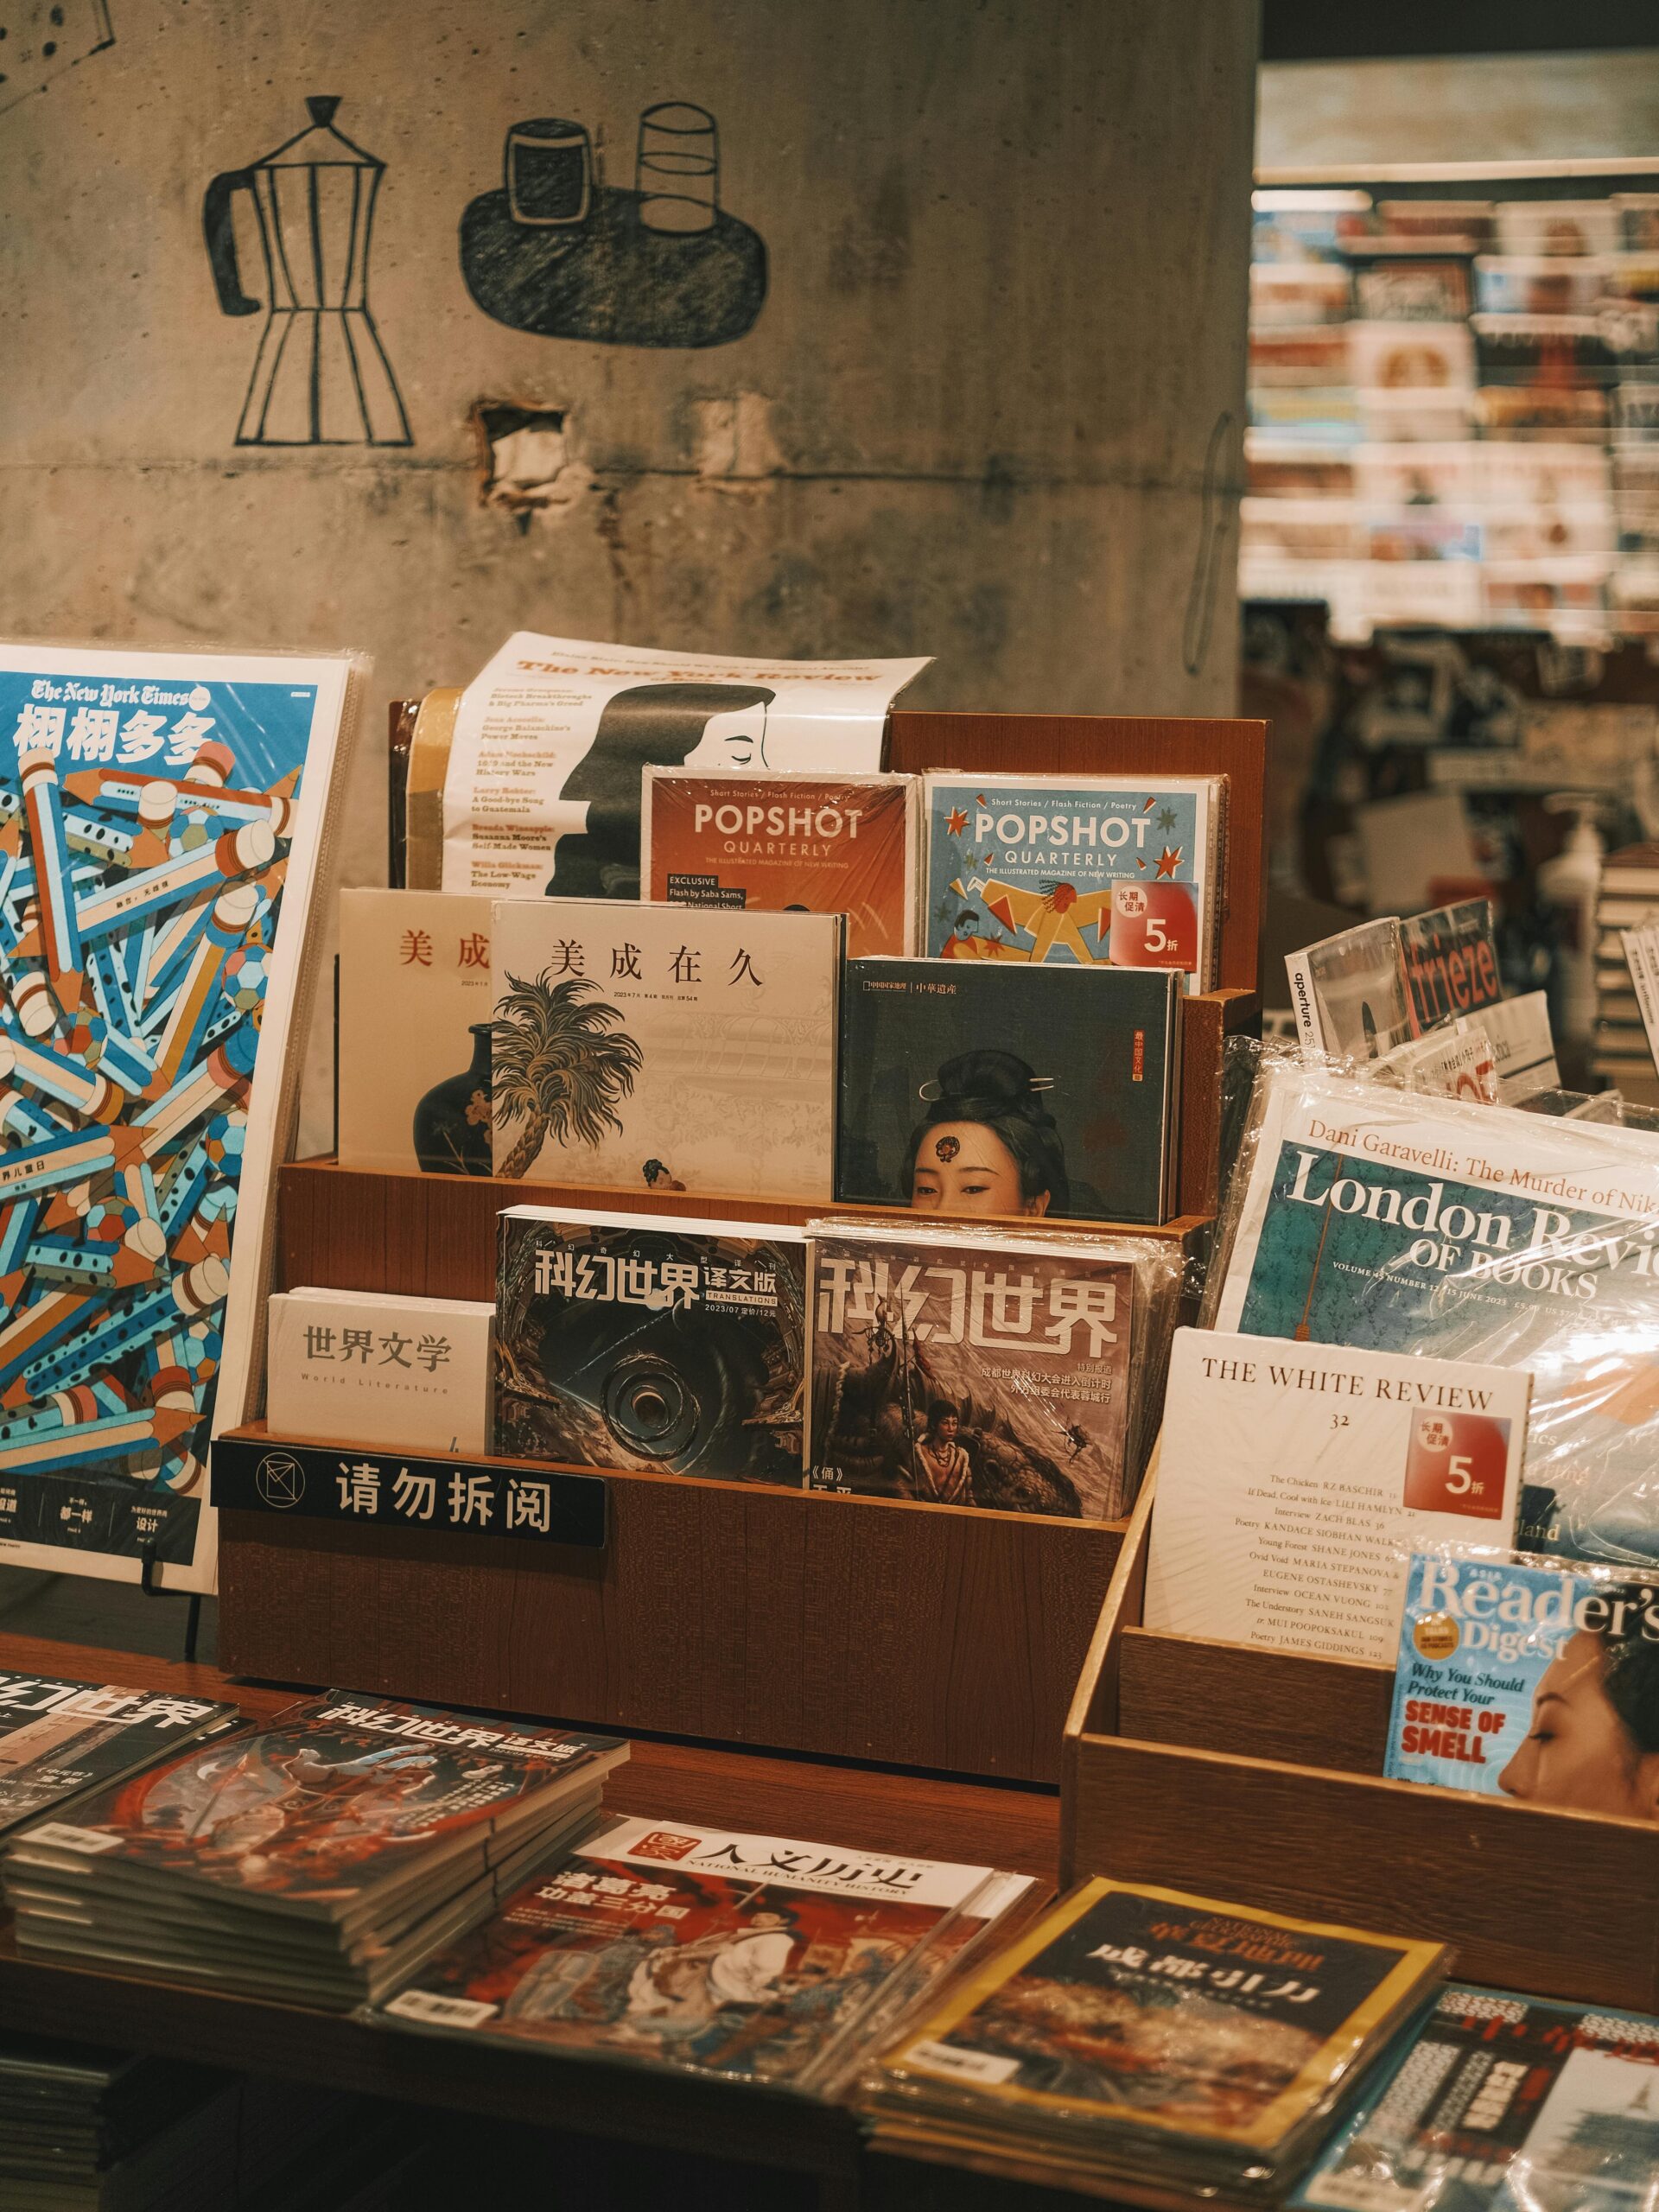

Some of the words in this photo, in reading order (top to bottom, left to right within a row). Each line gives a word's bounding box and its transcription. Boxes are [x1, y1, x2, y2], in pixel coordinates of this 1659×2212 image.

[517, 660, 579, 675] The
[586, 667, 658, 677] New
[664, 671, 741, 681] York
[750, 671, 883, 683] Review
[31, 679, 60, 701] The
[63, 682, 98, 702] New
[99, 685, 139, 708] York
[141, 686, 189, 707] Times
[13, 703, 216, 766] 栩栩多多
[710, 789, 731, 798] Short
[732, 790, 759, 799] Stories
[767, 791, 789, 800] Flash
[790, 792, 816, 801] Fiction
[991, 798, 1014, 807] Short
[1014, 798, 1042, 808] Stories
[1051, 799, 1072, 808] Flash
[1074, 800, 1101, 810] Fiction
[1110, 802, 1137, 812] Poetry
[695, 804, 863, 839] POPSHOT
[975, 813, 1151, 849] POPSHOT
[723, 840, 832, 857] QUARTERLY
[1005, 850, 1117, 868] QUARTERLY
[471, 880, 511, 889] Economy
[669, 875, 716, 887] EXCLUSIVE
[999, 868, 1039, 876] ILLUSTRATED
[1040, 868, 1077, 877] MAGAZINE
[690, 890, 699, 899] by
[701, 891, 720, 899] Saba
[721, 891, 744, 900] Sams,
[1118, 890, 1139, 902] 长期
[1124, 900, 1145, 912] 促清
[1144, 918, 1179, 952] 5折
[400, 930, 490, 969] 美成
[551, 939, 763, 987] 美成在久
[1409, 934, 1498, 1025] frieze
[1294, 972, 1312, 1028] aperture
[1308, 1119, 1359, 1147] Dani
[1363, 1134, 1459, 1173] Garavelli:
[1466, 1157, 1504, 1183] The
[1509, 1168, 1588, 1201] Murder
[1592, 1188, 1618, 1206] of
[1286, 1150, 1510, 1251] London
[535, 1249, 700, 1310] 科幻世界
[703, 1266, 778, 1294] 译文版
[1409, 1238, 1461, 1274] OF
[1467, 1249, 1599, 1300] BOOKS
[1332, 1262, 1372, 1277] VOLUME
[1386, 1274, 1427, 1290] NUMBER
[1446, 1288, 1458, 1297] 15
[1459, 1291, 1484, 1302] JUNE
[1484, 1296, 1507, 1306] 2023
[704, 1303, 739, 1314] 2023/07
[741, 1306, 778, 1319] 定价/12元
[707, 1292, 778, 1306] TRANSLATIONS
[817, 1257, 1118, 1359] 科幻世界
[302, 1325, 452, 1373] 世界文学
[1077, 1362, 1113, 1376] 特别报道
[301, 1372, 346, 1384] World
[358, 1378, 448, 1395] Literature
[1201, 1357, 1256, 1383] THE
[1268, 1365, 1364, 1396] WHITE
[1376, 1378, 1494, 1411] REVIEW
[1329, 1414, 1351, 1431] 32
[1421, 1421, 1444, 1436] 长期
[1426, 1433, 1451, 1447] 促清
[812, 1465, 843, 1482] 《俑》
[1270, 1474, 1285, 1484] The
[1287, 1476, 1319, 1489] Chicken
[1445, 1455, 1485, 1496] 5折
[335, 1462, 550, 1534] 请勿拆阅
[1280, 1491, 1299, 1503] Cool
[1300, 1496, 1319, 1505] with
[137, 1516, 159, 1534] 设计
[1235, 1517, 1261, 1529] Poetry
[1264, 1522, 1314, 1536] KANDACE
[1315, 1528, 1363, 1543] SIOBHAN
[1274, 1506, 1312, 1520] Interview
[1314, 1513, 1344, 1524] ZACH
[1345, 1516, 1371, 1529] BLAS
[1249, 1551, 1268, 1562] Ovid
[1270, 1554, 1289, 1564] Void
[1293, 1557, 1327, 1571] MARIA
[1257, 1536, 1283, 1549] Young
[1284, 1540, 1308, 1552] Forest
[1312, 1544, 1347, 1557] SHANE
[1348, 1548, 1382, 1562] JONES
[1262, 1569, 1304, 1583] EUGENE
[1306, 1576, 1380, 1593] OSTASHEVSKY
[1253, 1584, 1290, 1597] Interview
[1294, 1590, 1331, 1602] OCEAN
[1333, 1595, 1372, 1609] VUONG
[1418, 1561, 1659, 1641] Reader's
[1245, 1599, 1262, 1609] The
[1262, 1600, 1306, 1616] Understory
[1308, 1608, 1344, 1621] SANEH
[1267, 1618, 1288, 1629] MUI
[1250, 1630, 1276, 1643] Poetry
[1278, 1635, 1313, 1648] JAMES
[1314, 1639, 1365, 1656] GIDDINGS
[1464, 1620, 1568, 1663] Digest
[1411, 1662, 1443, 1683] Why
[1447, 1667, 1473, 1686] You
[1475, 1673, 1525, 1693] Should
[1407, 1681, 1460, 1700] Protect
[1461, 1688, 1495, 1705] Your
[316, 1702, 506, 1750] 科幻世界
[501, 1735, 585, 1755] 译文版
[1404, 1700, 1473, 1728] SENSE
[1478, 1711, 1506, 1734] OF
[1401, 1726, 1486, 1764] SMELL
[686, 1859, 760, 1876] NATIONAL
[762, 1870, 842, 1886] HUMANITY
[844, 1879, 911, 1897] HISTORY
[696, 1842, 924, 1890] 人文历史
[551, 1870, 679, 1902] 诸葛亮
[535, 1886, 692, 1922] 功盖三分国
[1086, 1943, 1321, 2004] 成都引力
